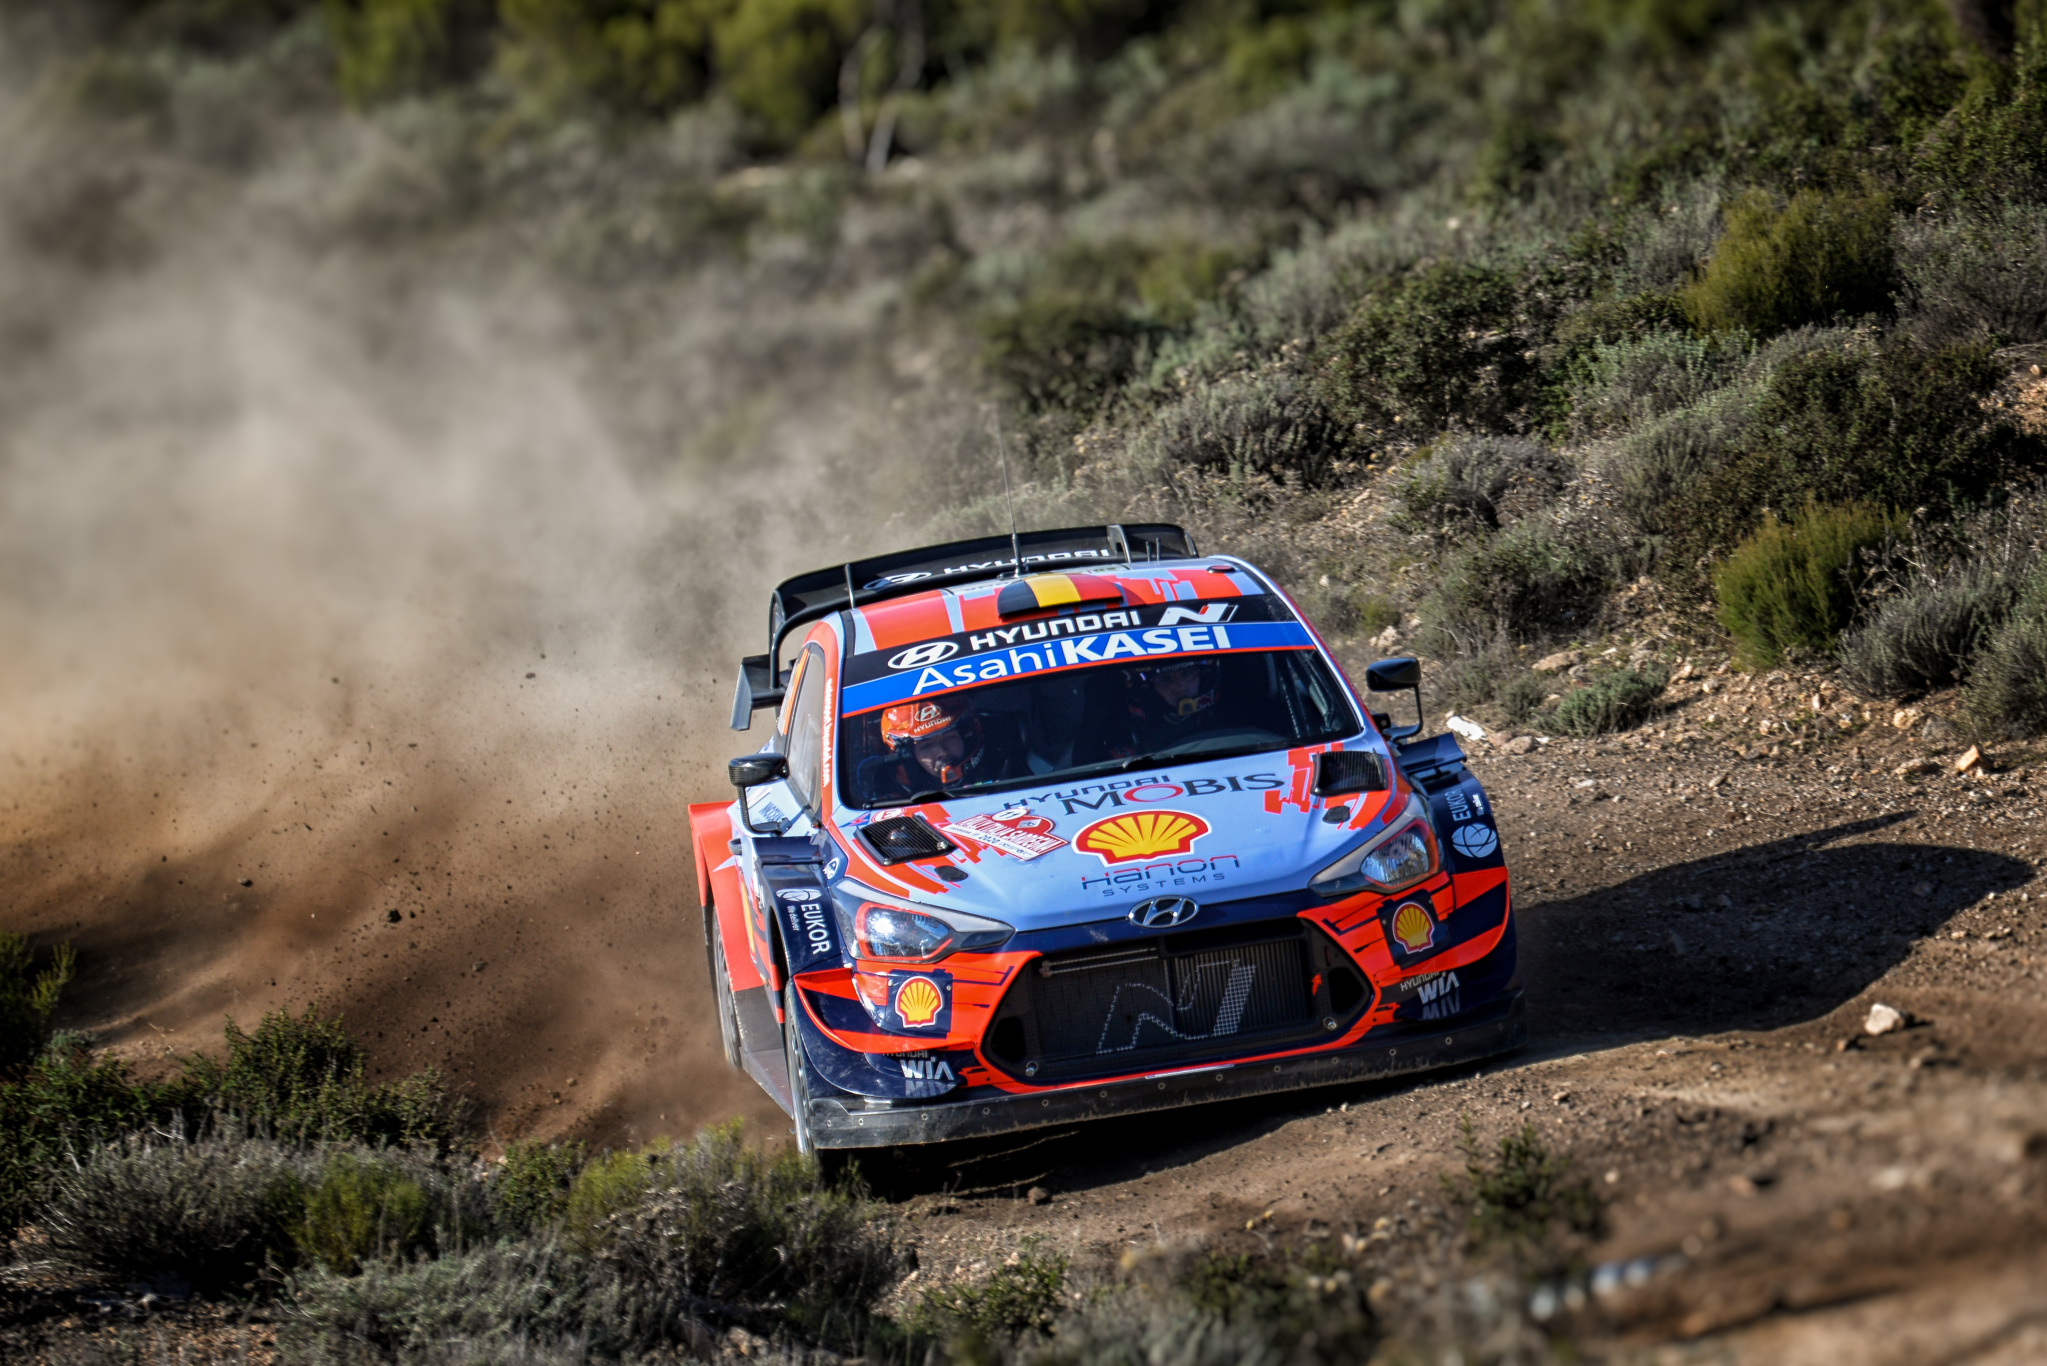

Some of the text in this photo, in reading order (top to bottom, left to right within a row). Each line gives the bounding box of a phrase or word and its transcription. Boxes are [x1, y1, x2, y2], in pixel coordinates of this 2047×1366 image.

[971, 611, 1141, 650] HYUNDAI
[913, 717, 951, 733] HYUNDAI
[1003, 776, 1170, 809] HYUNDAI
[1061, 773, 1284, 815] MOBIS
[1102, 873, 1225, 896] SYSTEMS
[801, 903, 831, 954] EUKOR
[1417, 971, 1459, 1005] WIA
[900, 1057, 954, 1080] WIA
